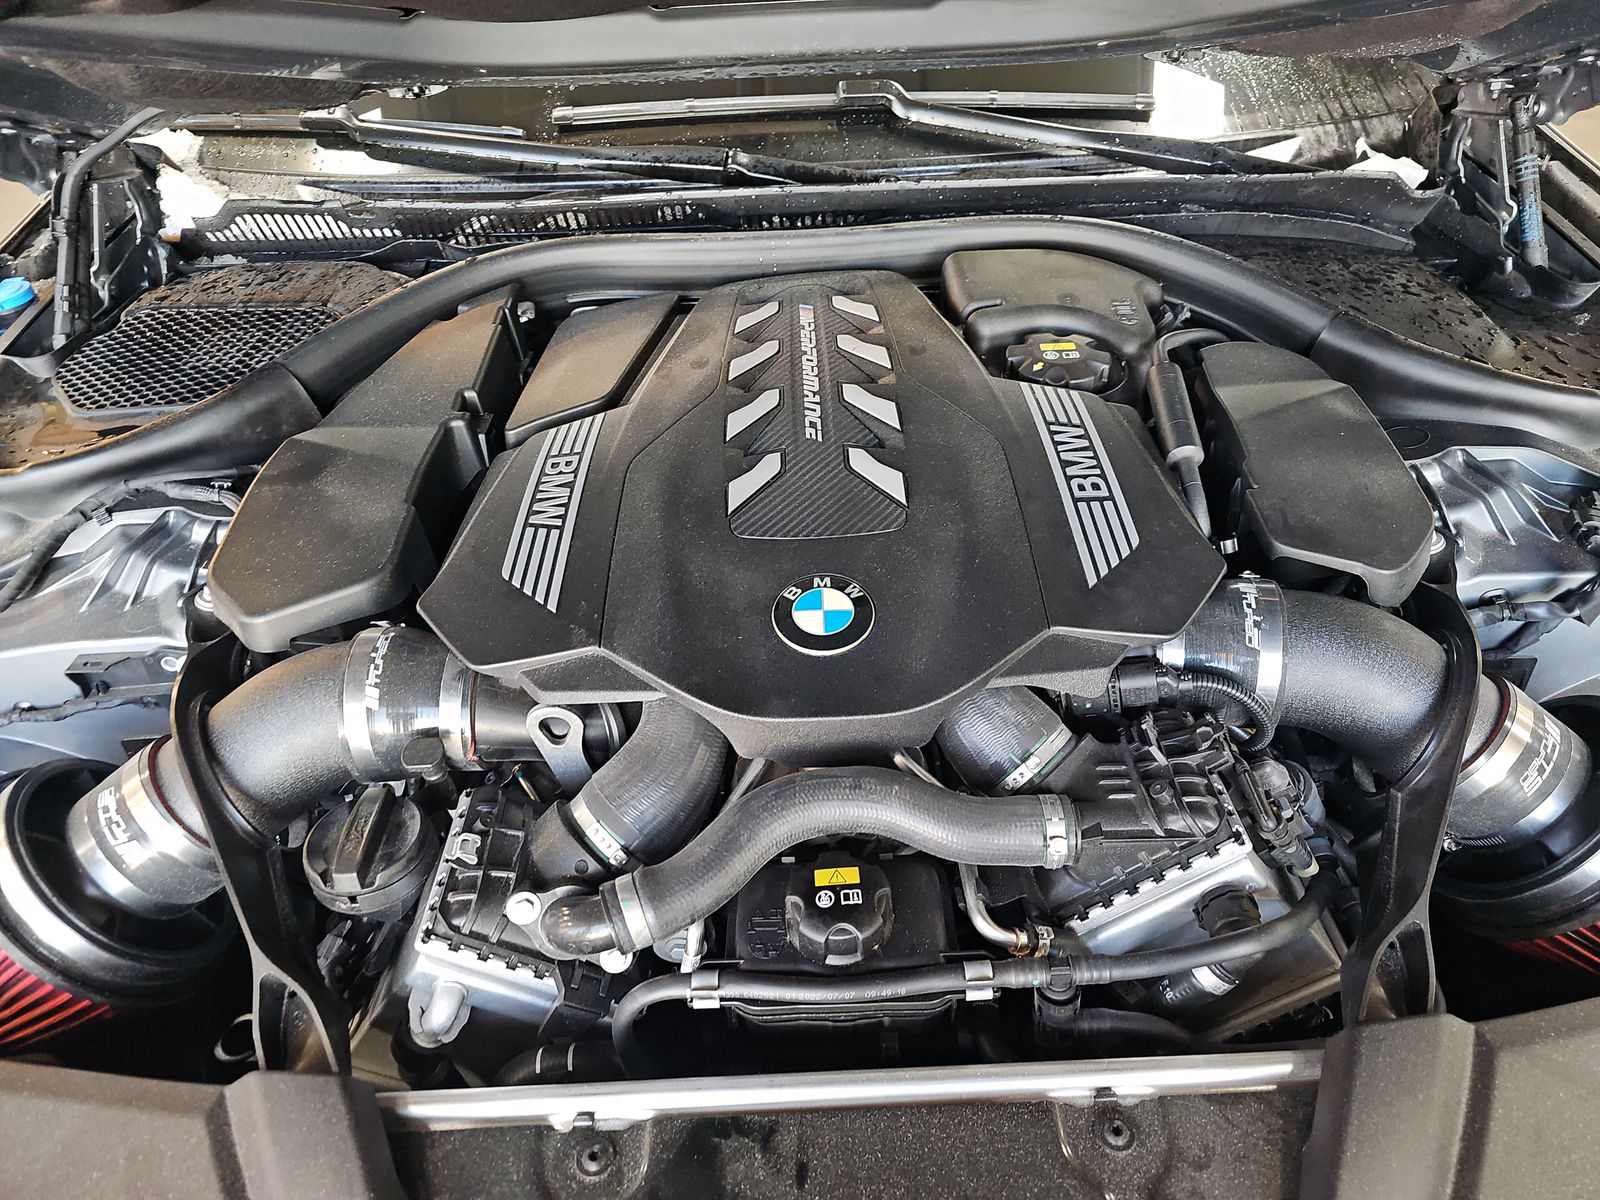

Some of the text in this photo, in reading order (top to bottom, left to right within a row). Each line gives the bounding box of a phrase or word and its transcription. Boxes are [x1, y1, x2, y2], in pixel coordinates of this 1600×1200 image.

[1050, 424, 1110, 499] BMW
[528, 454, 580, 526] BMW
[783, 576, 864, 601] BMW
[1241, 592, 1255, 648] TURBO
[1519, 733, 1551, 785] TURBO
[1524, 743, 1560, 797] CTS
